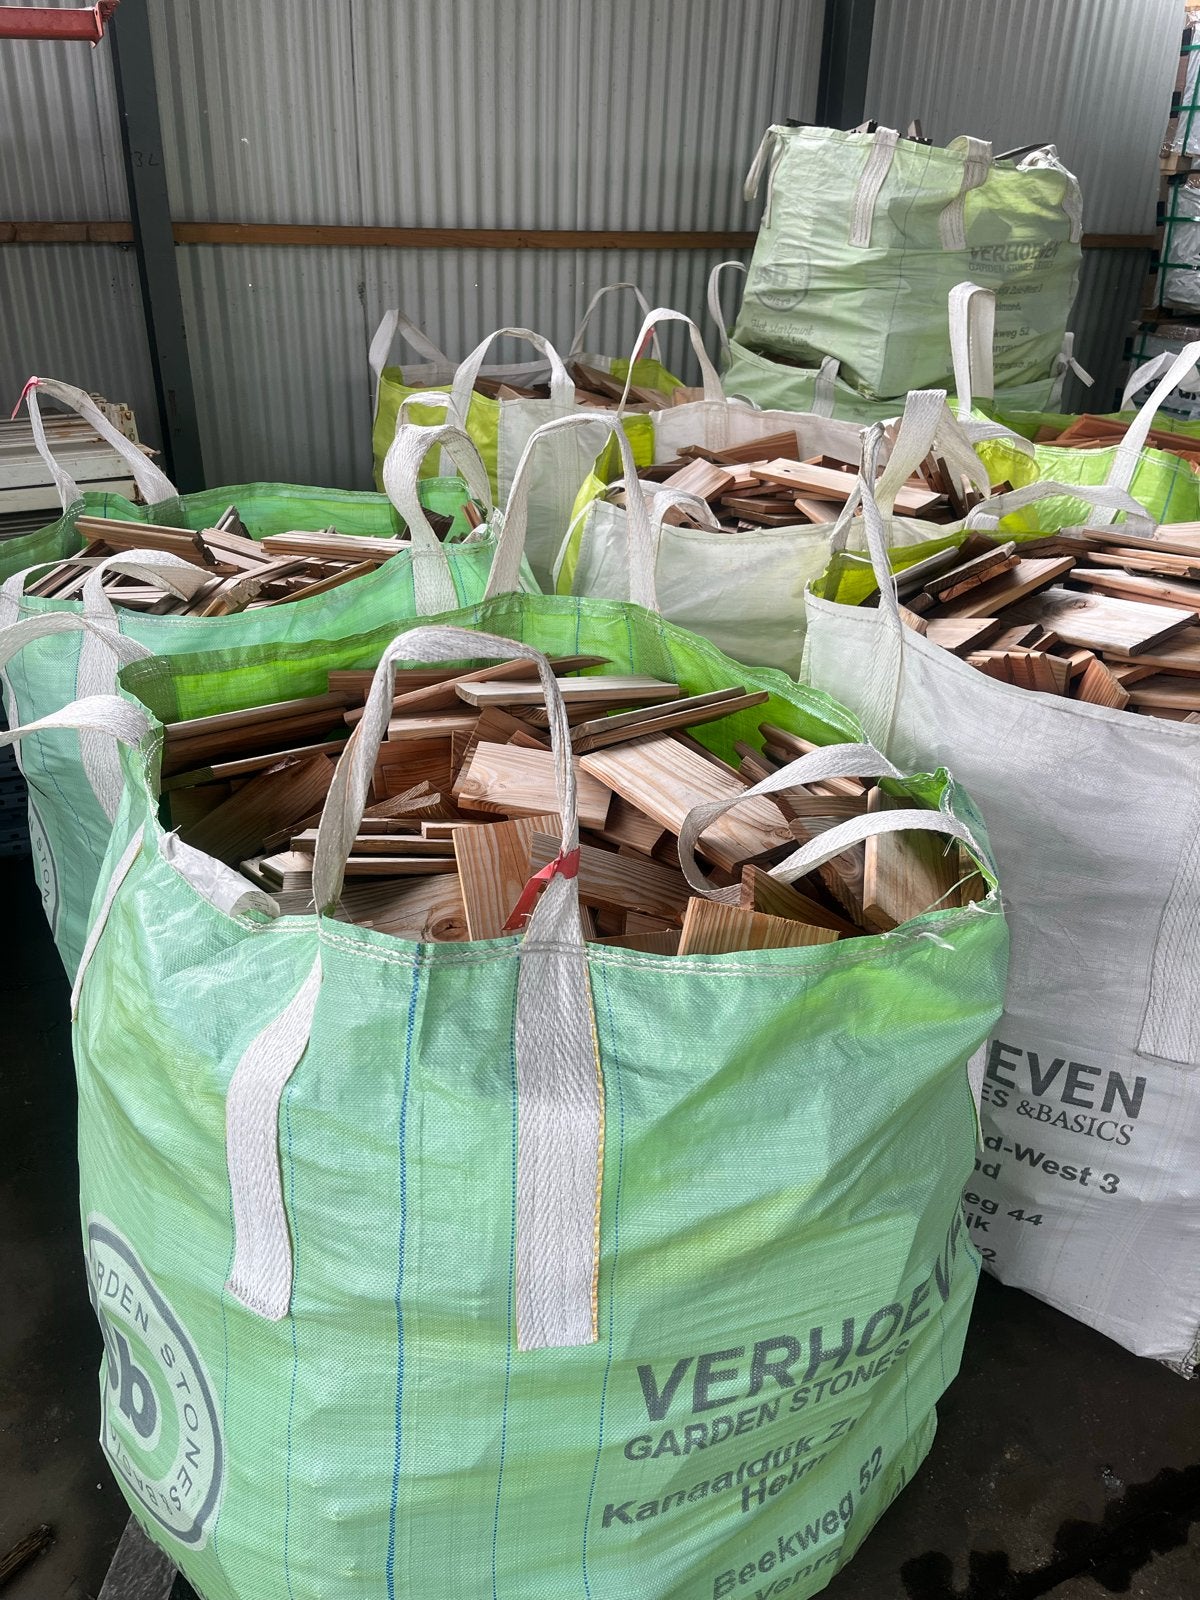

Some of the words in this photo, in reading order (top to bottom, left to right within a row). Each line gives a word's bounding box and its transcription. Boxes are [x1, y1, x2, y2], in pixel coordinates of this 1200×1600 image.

[986, 1039, 1147, 1119] EVEN
[984, 1136, 1093, 1186] d-West
[1099, 1172, 1121, 1195] 3
[1007, 1208, 1043, 1227] 44
[624, 1398, 780, 1461] GARDEN
[601, 1436, 815, 1528] Kanaaldijk
[713, 1490, 854, 1600] Beekweg
[859, 1445, 882, 1495] 52
[755, 1546, 843, 1600] Venra
